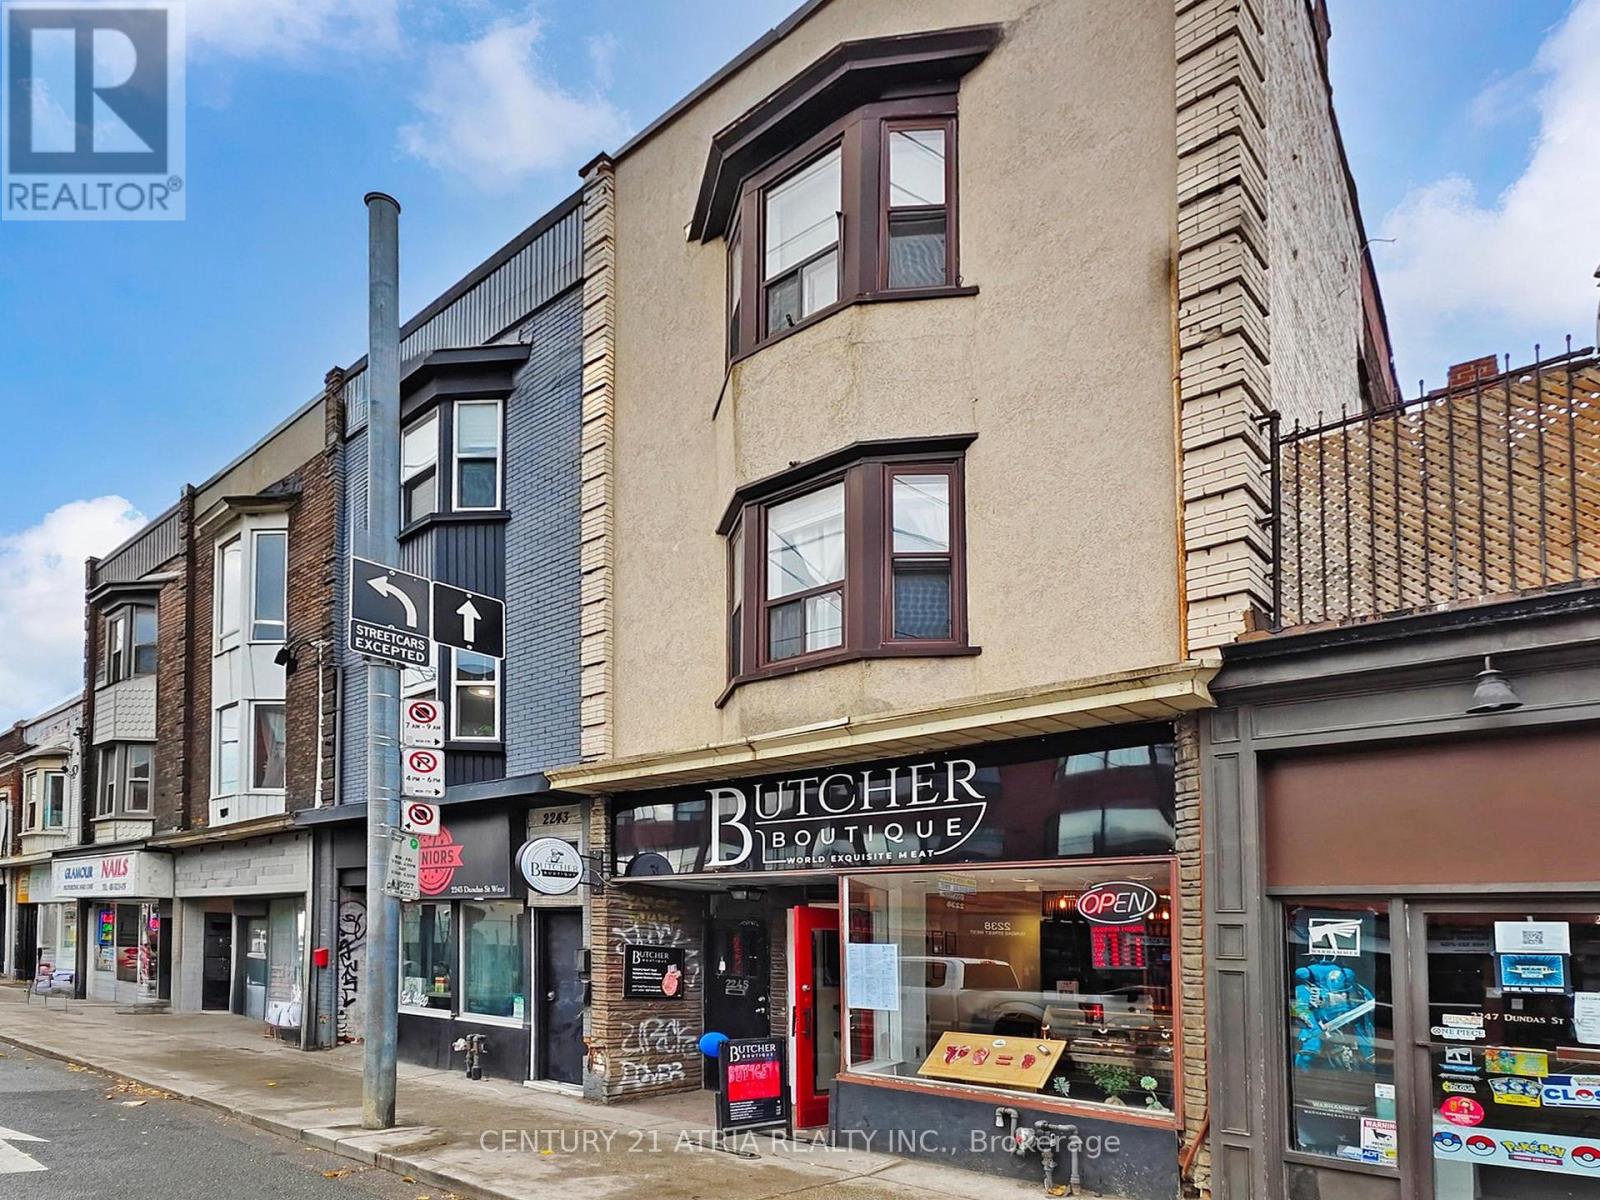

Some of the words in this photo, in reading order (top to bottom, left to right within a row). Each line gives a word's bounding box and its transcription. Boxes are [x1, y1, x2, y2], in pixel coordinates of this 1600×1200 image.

[356, 624, 425, 651] STREETCARS
[355, 637, 425, 662] EXCEPTED
[543, 811, 569, 825] 2243
[704, 759, 986, 867] BUTCHER
[772, 817, 963, 849] BOUTIQUE
[421, 850, 454, 865] NIORS
[786, 856, 826, 865] WORLD
[831, 852, 893, 864] EXQUISITE
[899, 849, 935, 859] MEAT
[64, 866, 93, 880] GLAMOUR
[101, 857, 129, 878] NAILS
[491, 884, 505, 893] West
[1082, 892, 1149, 914] OPEN
[632, 950, 670, 964] BUTCHER
[1504, 1014, 1546, 1024] DUNDAS
[1456, 1029, 1484, 1037] PIECE
[730, 1044, 776, 1063] BUTCHER
[1365, 1120, 1397, 1131] WARNIN
